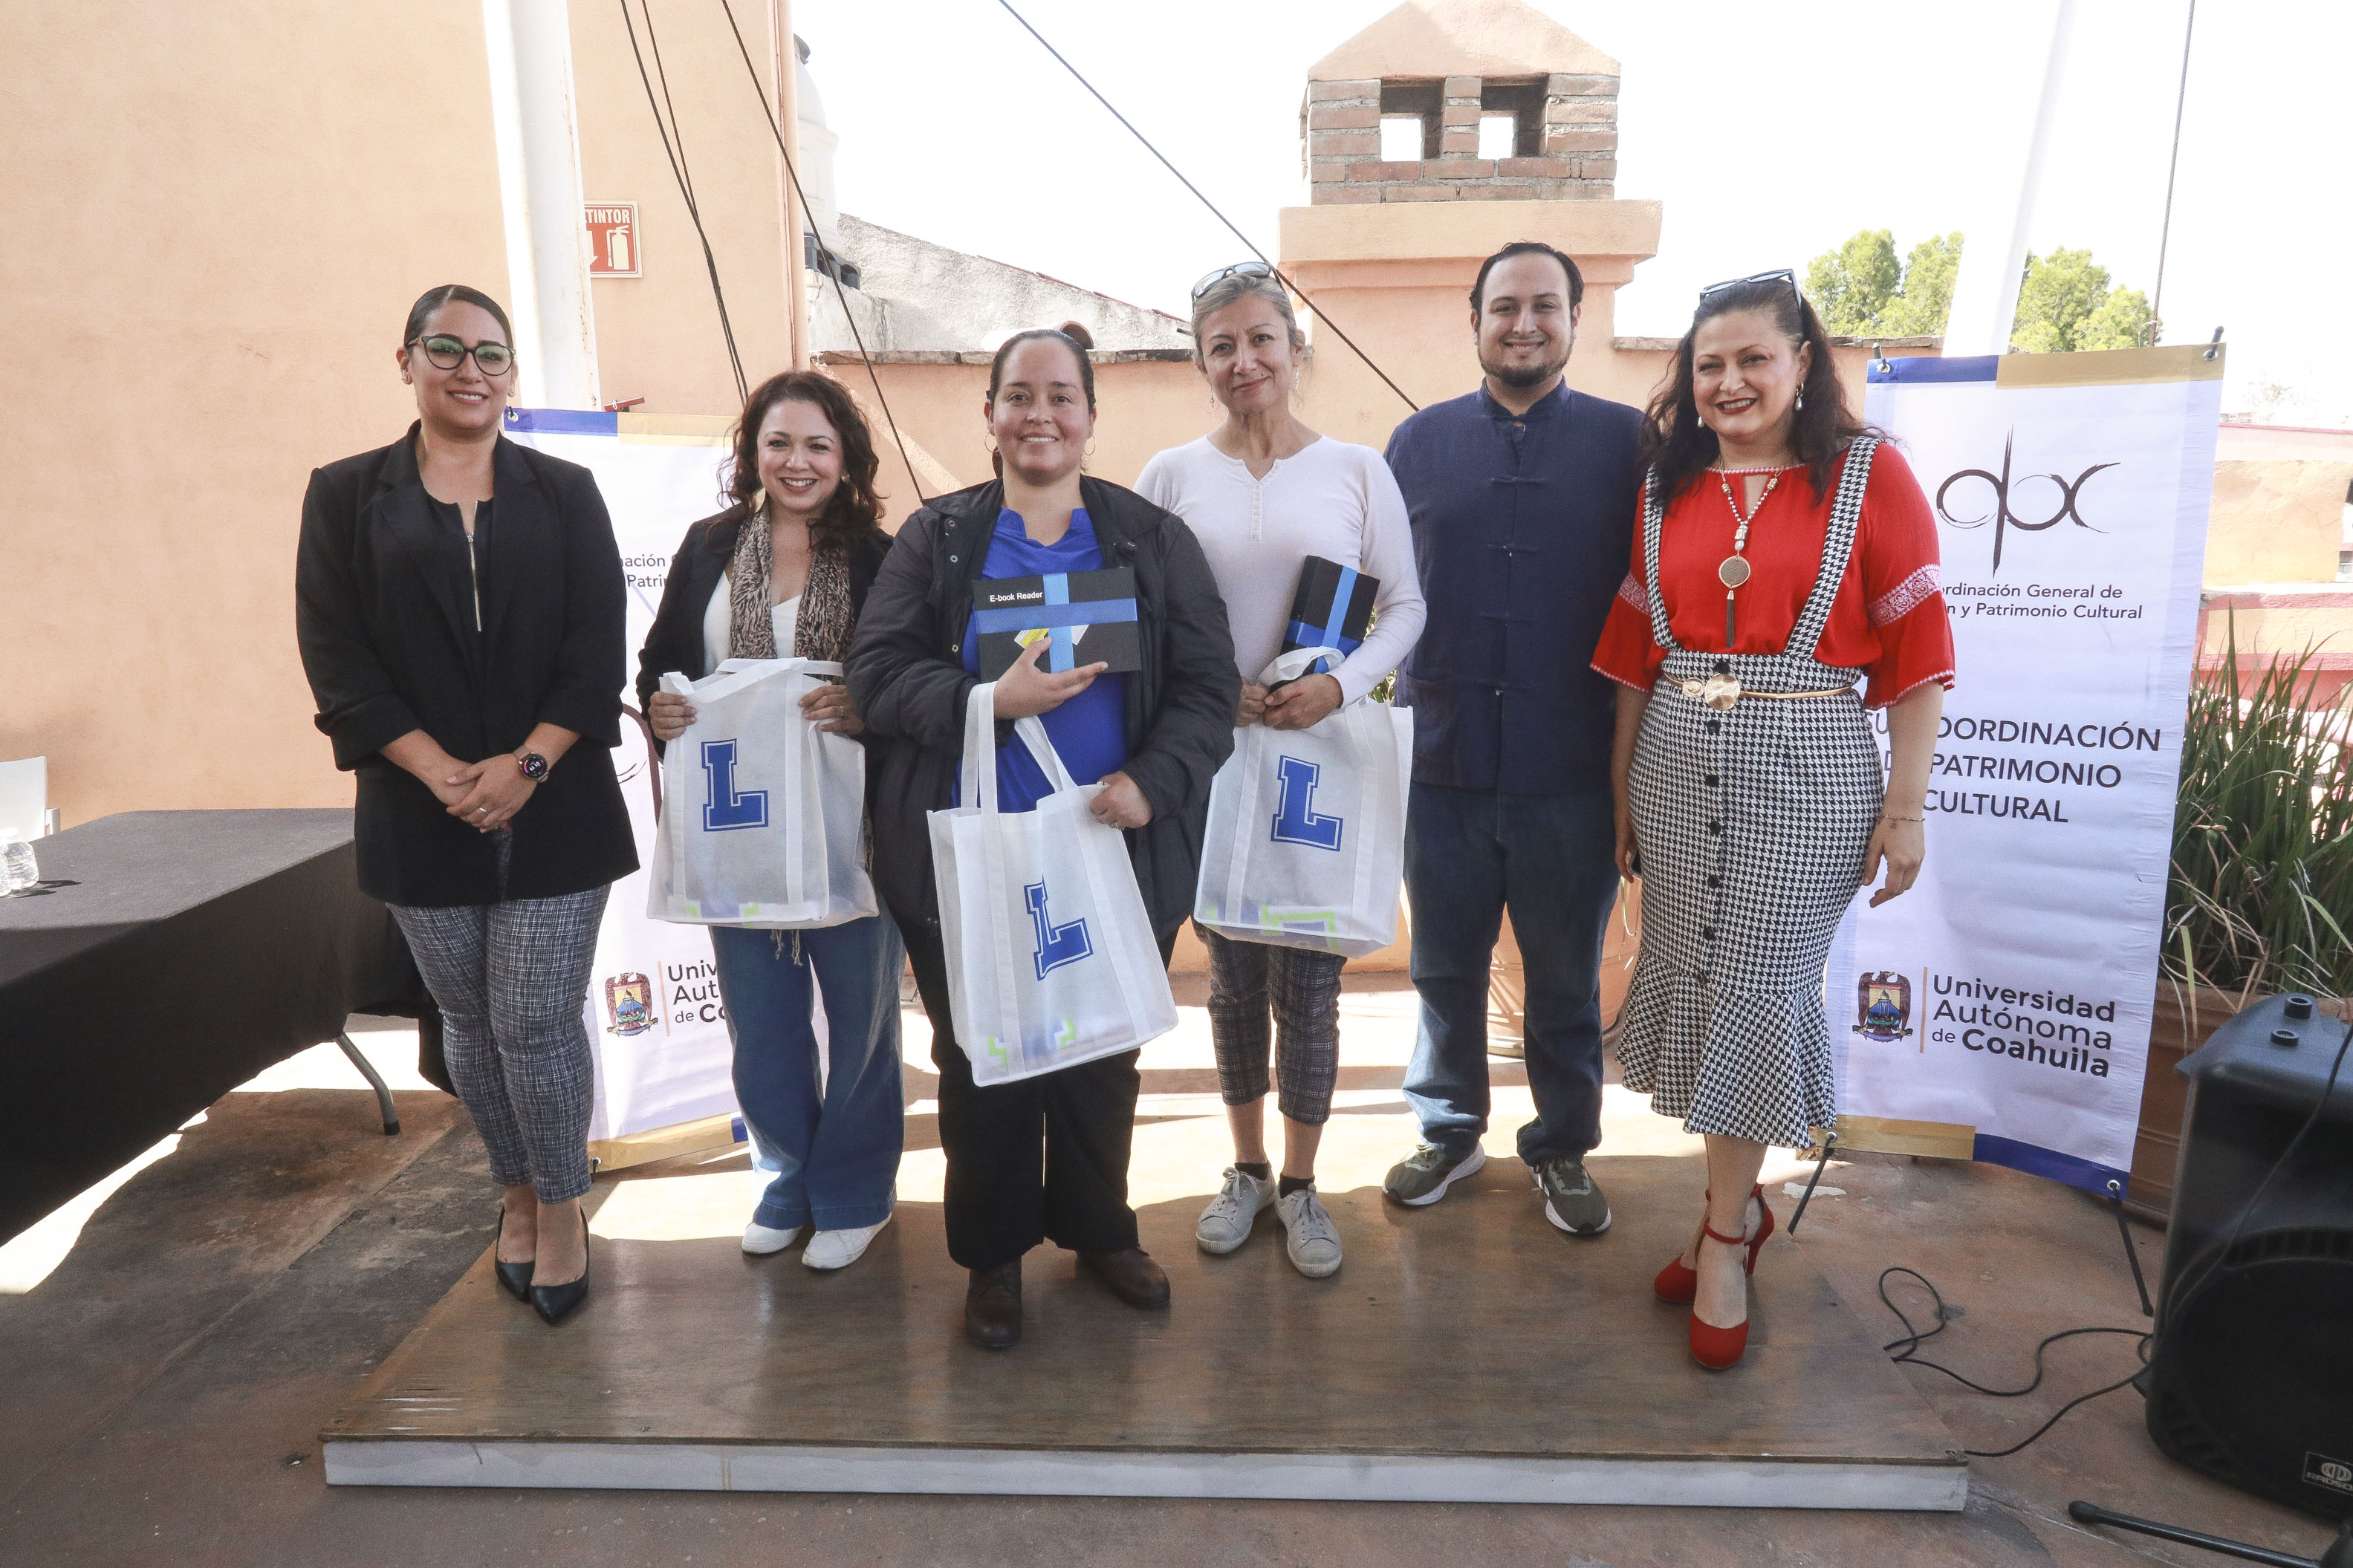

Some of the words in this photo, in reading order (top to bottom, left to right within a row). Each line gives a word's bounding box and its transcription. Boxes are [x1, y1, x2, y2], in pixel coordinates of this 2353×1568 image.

[585, 209, 631, 224] TINTOR
[623, 553, 666, 567] ación
[990, 593, 1016, 602] E-book
[1016, 591, 1043, 600] Reader
[2026, 583, 2094, 599] General
[2100, 585, 2123, 599] de
[1960, 605, 1971, 618] y
[1976, 602, 2068, 618] Patrimonio
[2073, 605, 2143, 619] Cultural
[1930, 753, 2121, 788] PATRIMONIO
[701, 738, 769, 832] L
[1270, 755, 1343, 852] L
[1923, 789, 2069, 824] CULTURAL
[1023, 874, 1094, 981] L
[668, 960, 717, 982] Univ
[673, 980, 719, 1006] Aut
[1933, 975, 2116, 1023] Universidad
[675, 1010, 694, 1024] de
[1932, 999, 2112, 1050] Autónoma
[1931, 1028, 1956, 1043] de
[1961, 1028, 2110, 1078] Coahuila
[2306, 1471, 2353, 1491] RADSO
